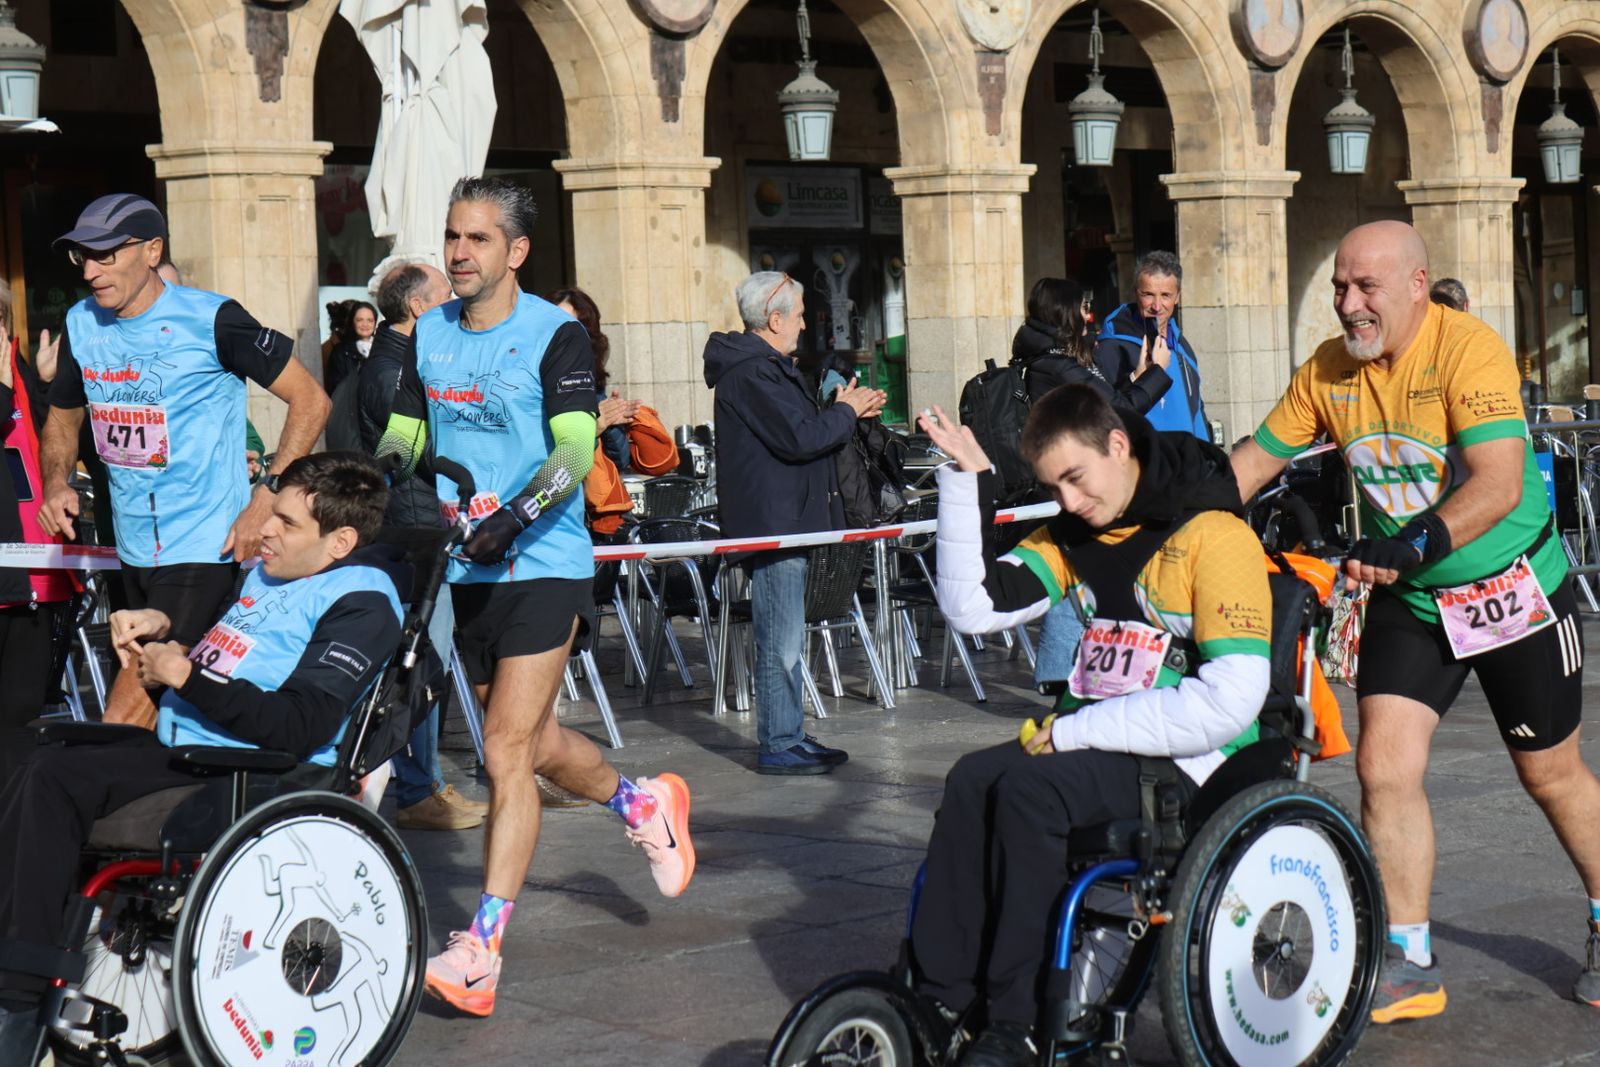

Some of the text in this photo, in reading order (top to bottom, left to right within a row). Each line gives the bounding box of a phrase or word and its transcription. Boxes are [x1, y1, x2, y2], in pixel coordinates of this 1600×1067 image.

[787, 182, 848, 200] Limcasa
[106, 424, 147, 449] 471
[1464, 590, 1524, 629] 202
[1085, 646, 1135, 677] 201
[354, 860, 386, 926] Pablo
